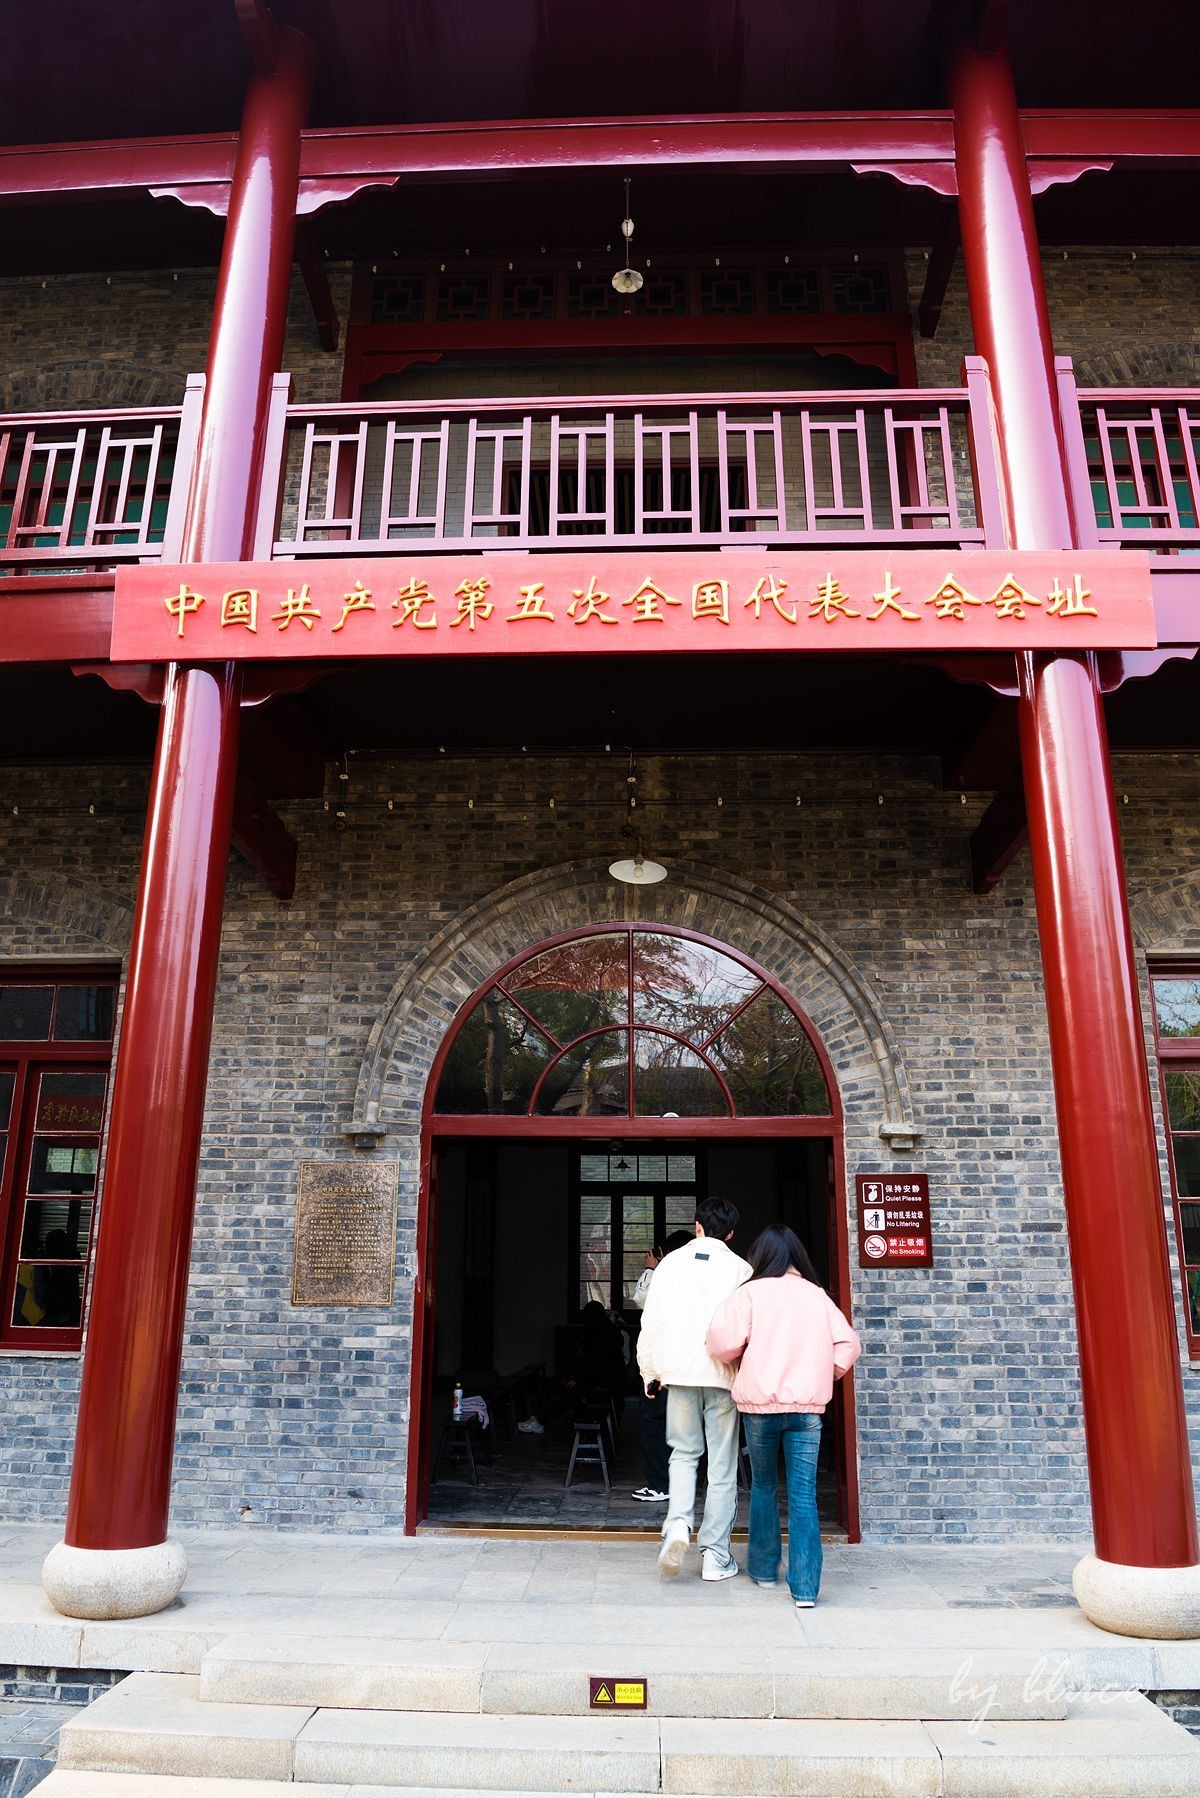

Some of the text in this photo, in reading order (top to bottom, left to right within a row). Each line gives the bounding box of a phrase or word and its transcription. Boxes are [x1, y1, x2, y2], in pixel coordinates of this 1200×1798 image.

[163, 573, 1100, 638] 中国共产党第五次全国代表大会会址
[885, 1185, 920, 1193] 保持安静
[889, 1238, 924, 1247] 禁止吸烟
